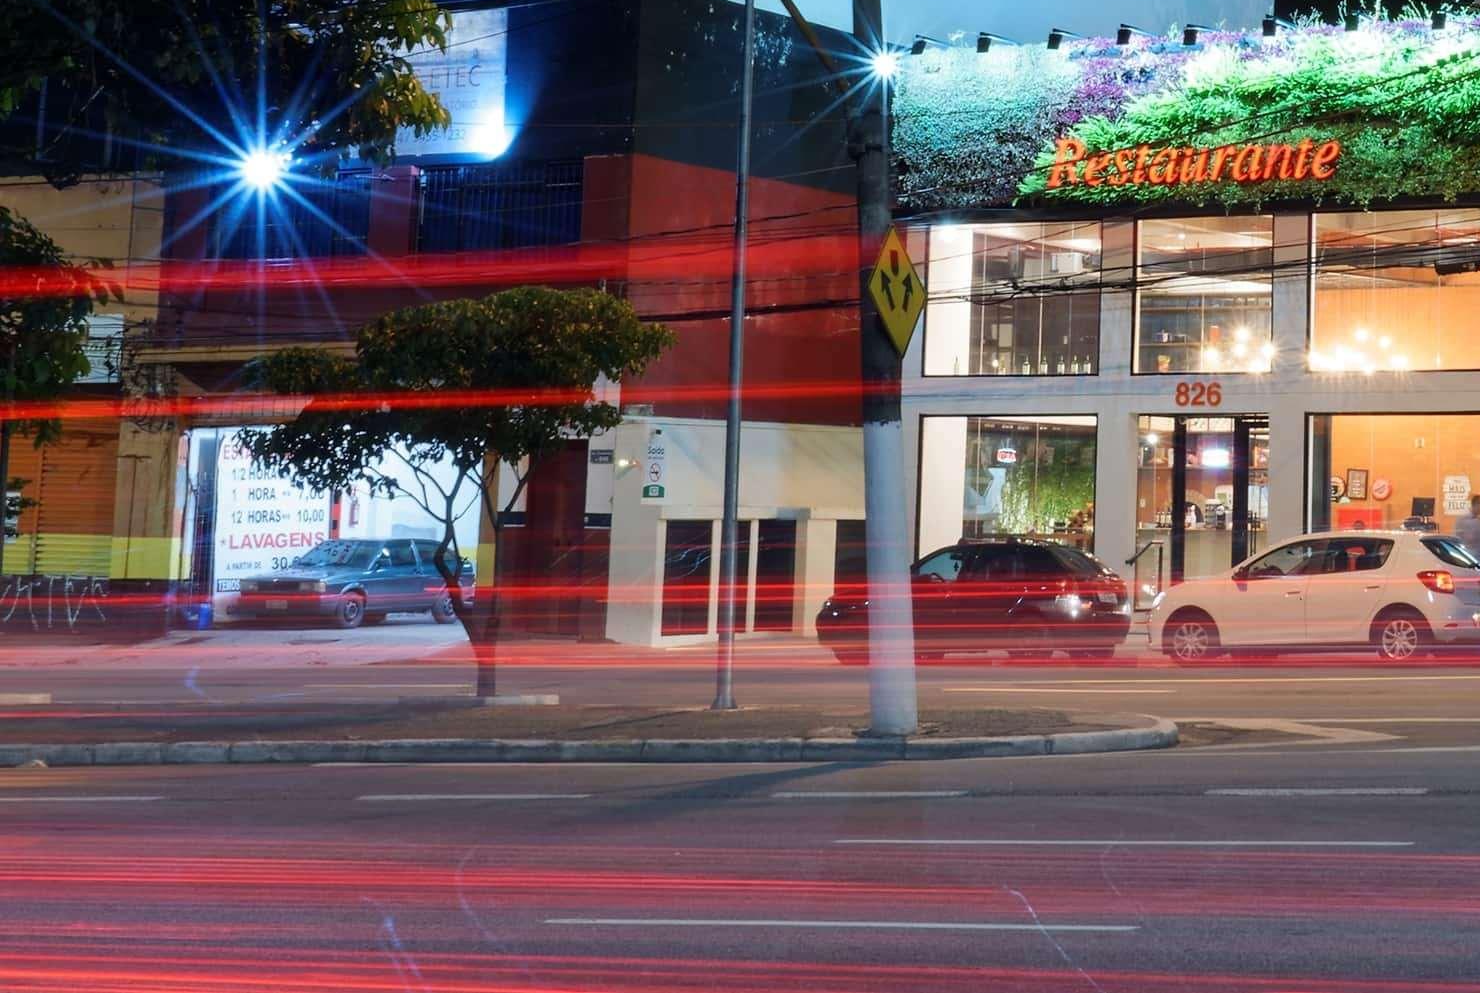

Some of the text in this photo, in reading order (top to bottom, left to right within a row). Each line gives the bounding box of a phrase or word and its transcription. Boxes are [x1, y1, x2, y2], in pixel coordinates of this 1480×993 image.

[1046, 136, 1341, 189] Restaurante
[1176, 382, 1222, 406] 826
[248, 487, 277, 501] HORA
[248, 510, 281, 523] HORAS
[229, 532, 324, 549] LAVAGENS
